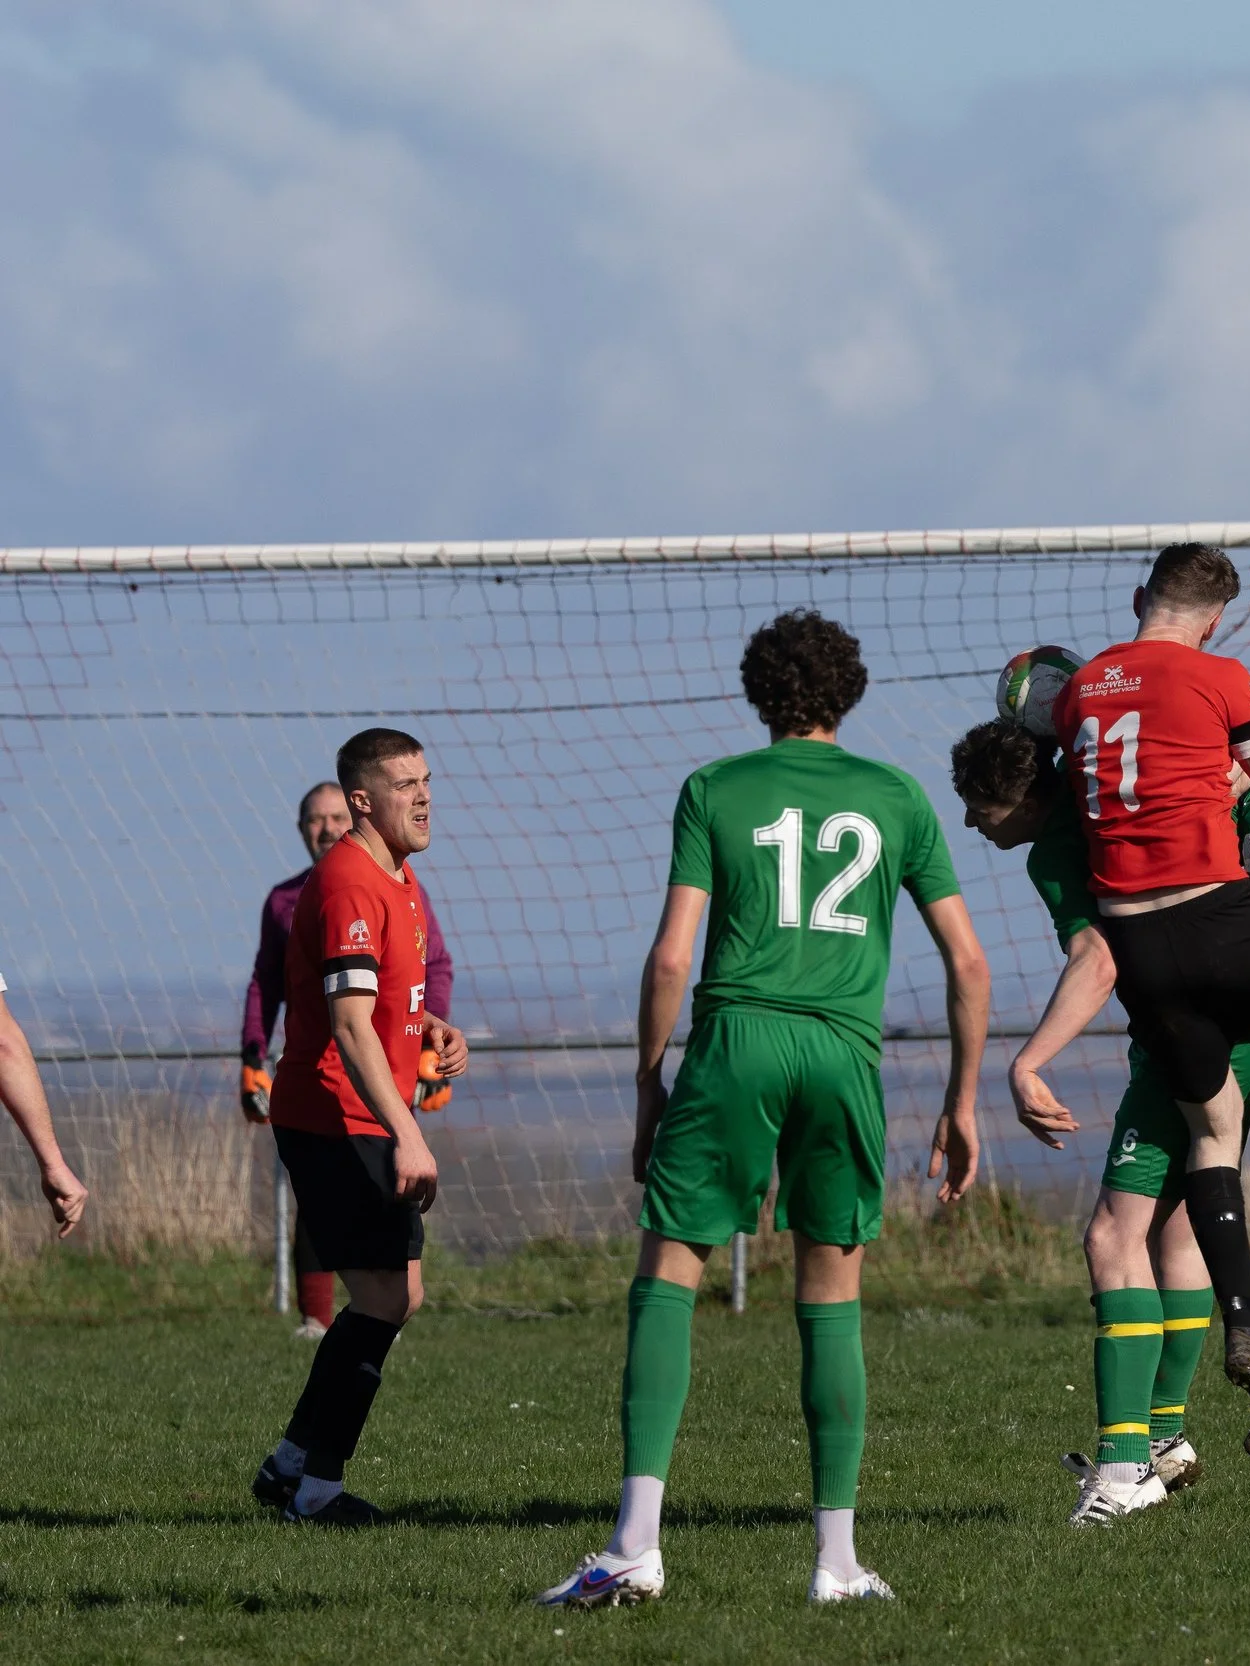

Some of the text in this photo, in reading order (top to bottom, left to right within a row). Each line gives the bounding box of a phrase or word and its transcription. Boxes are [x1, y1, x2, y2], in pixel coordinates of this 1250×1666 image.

[1079, 685, 1140, 699] cleaning services
[1080, 676, 1142, 693] RG HOWELLS
[1073, 711, 1141, 819] 11
[753, 807, 882, 936] 12
[409, 981, 426, 1014] F
[405, 1023, 424, 1037] AU
[1121, 1127, 1139, 1153] 6
